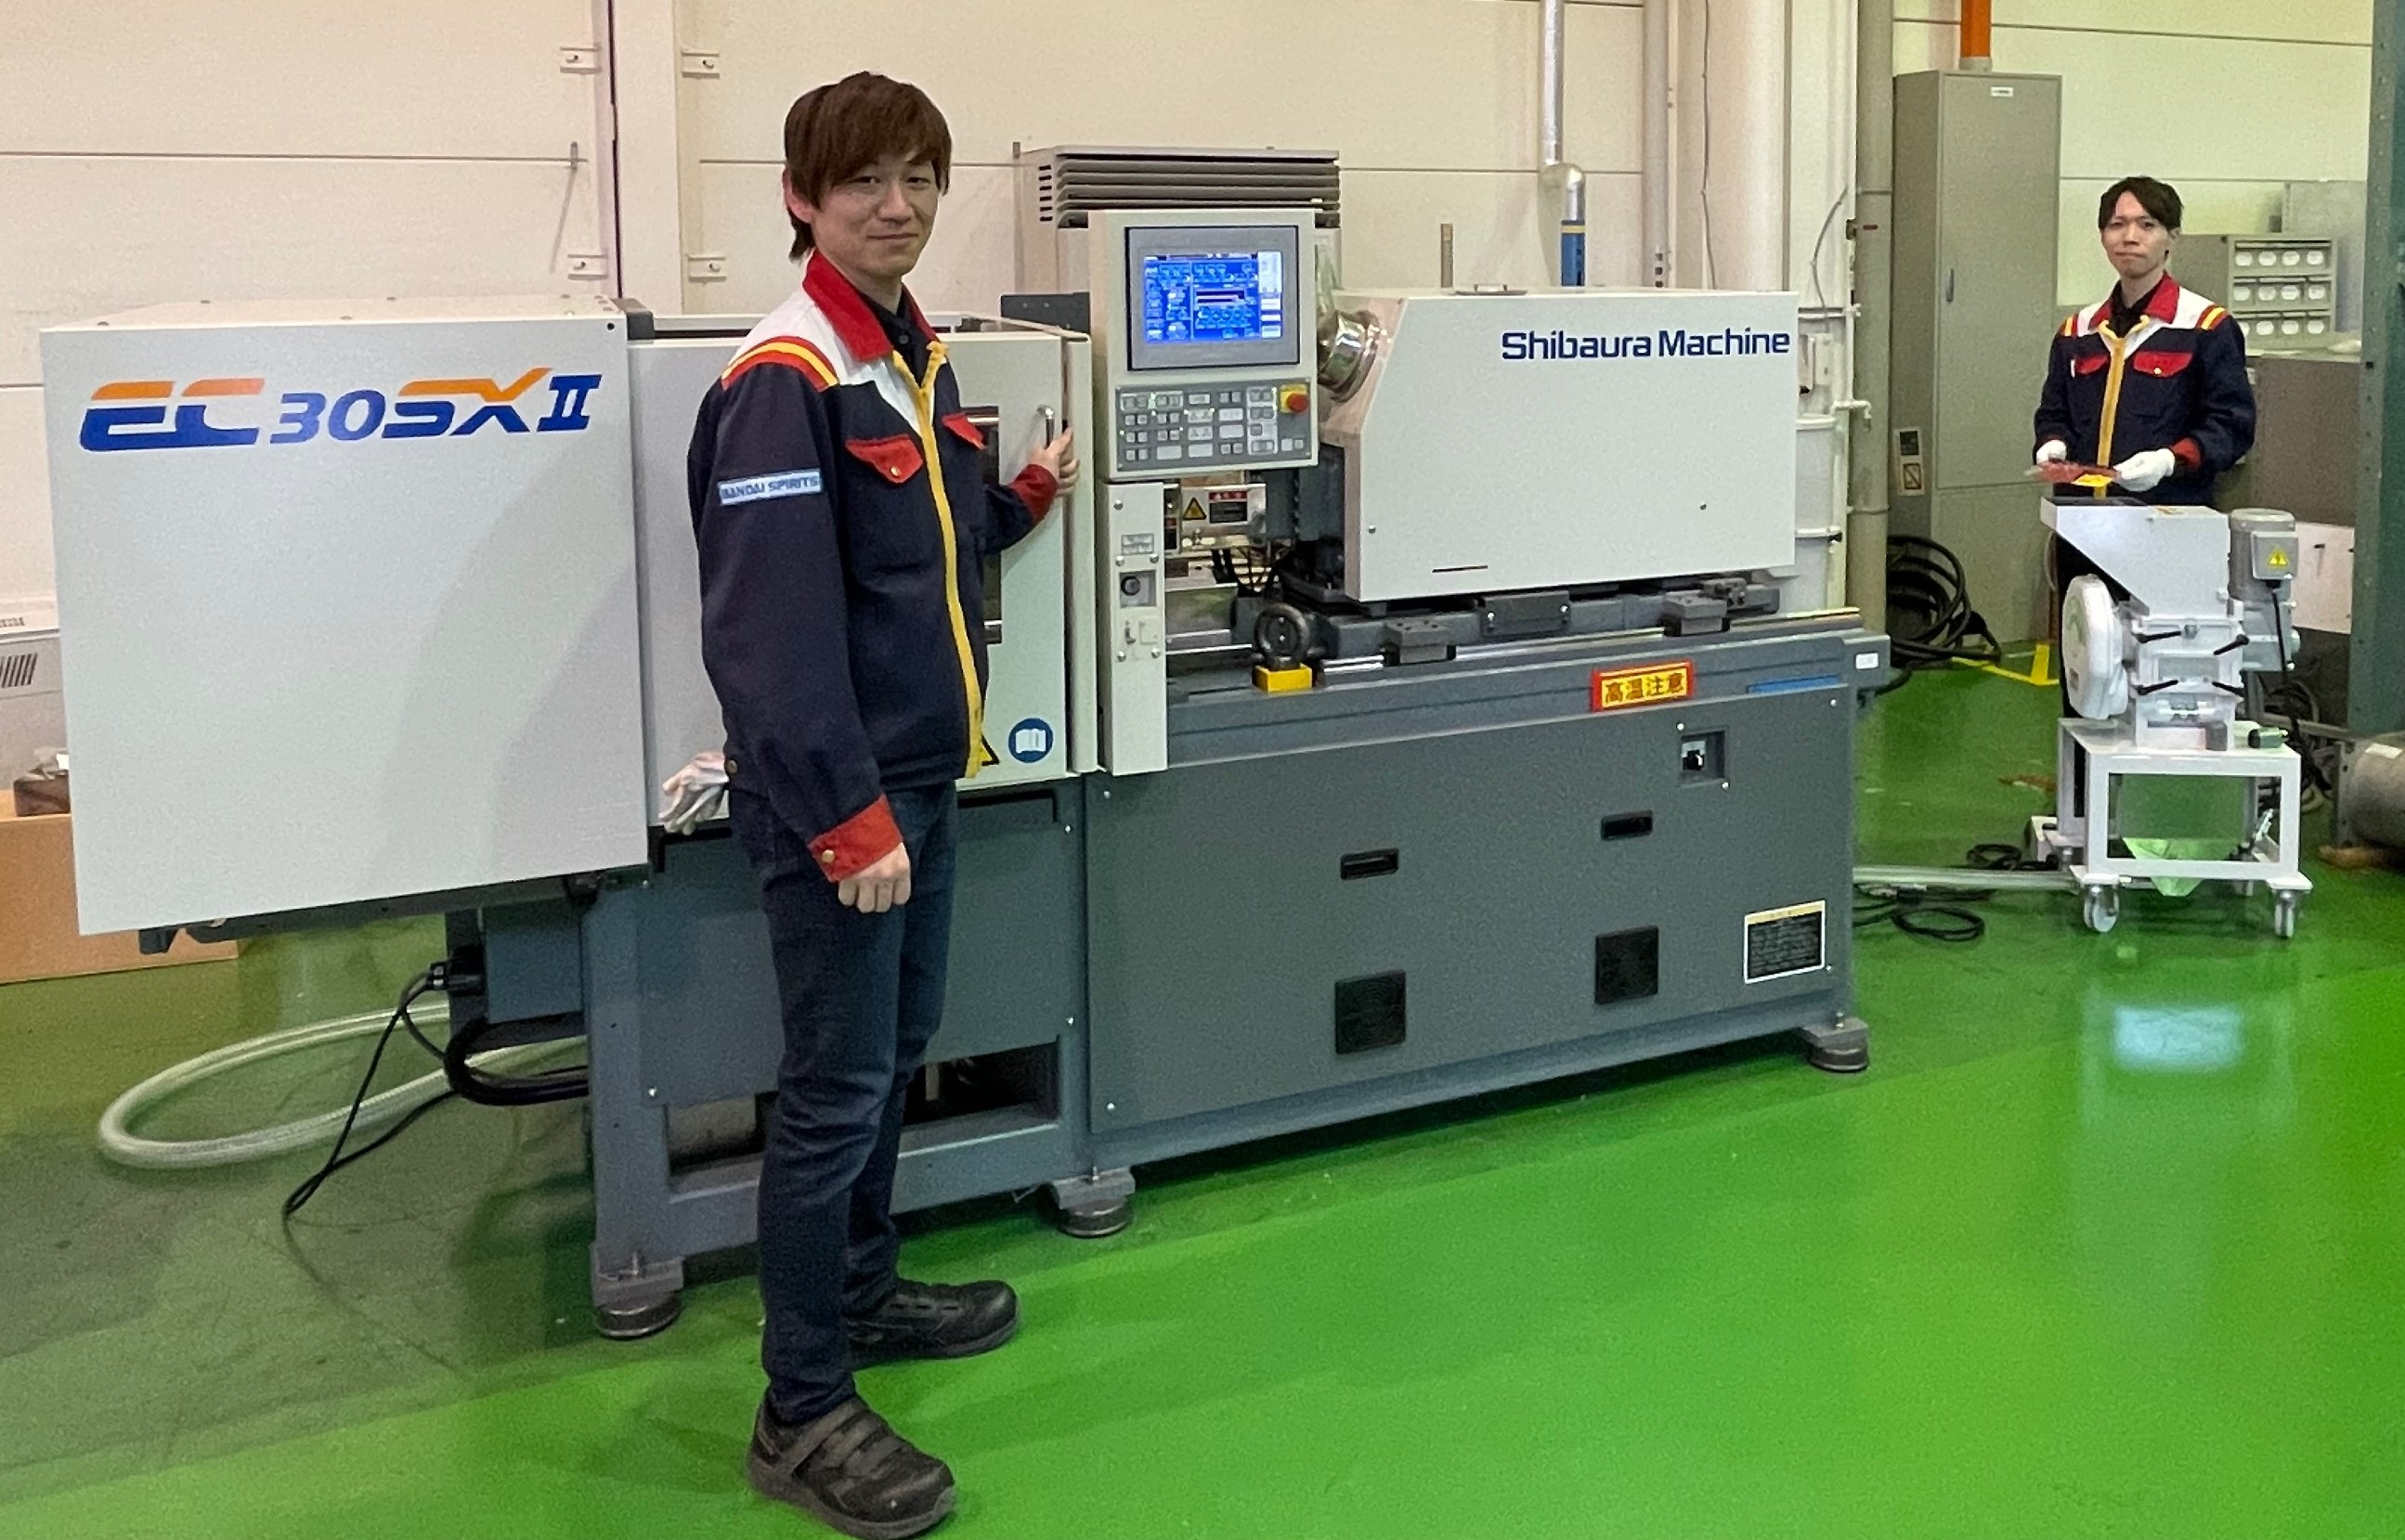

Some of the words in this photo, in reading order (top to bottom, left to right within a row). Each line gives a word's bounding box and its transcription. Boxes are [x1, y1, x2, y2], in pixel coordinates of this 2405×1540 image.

[1502, 330, 1651, 360] Shibaura
[1658, 327, 1790, 357] Machine
[1605, 672, 1684, 705] 高温注意
